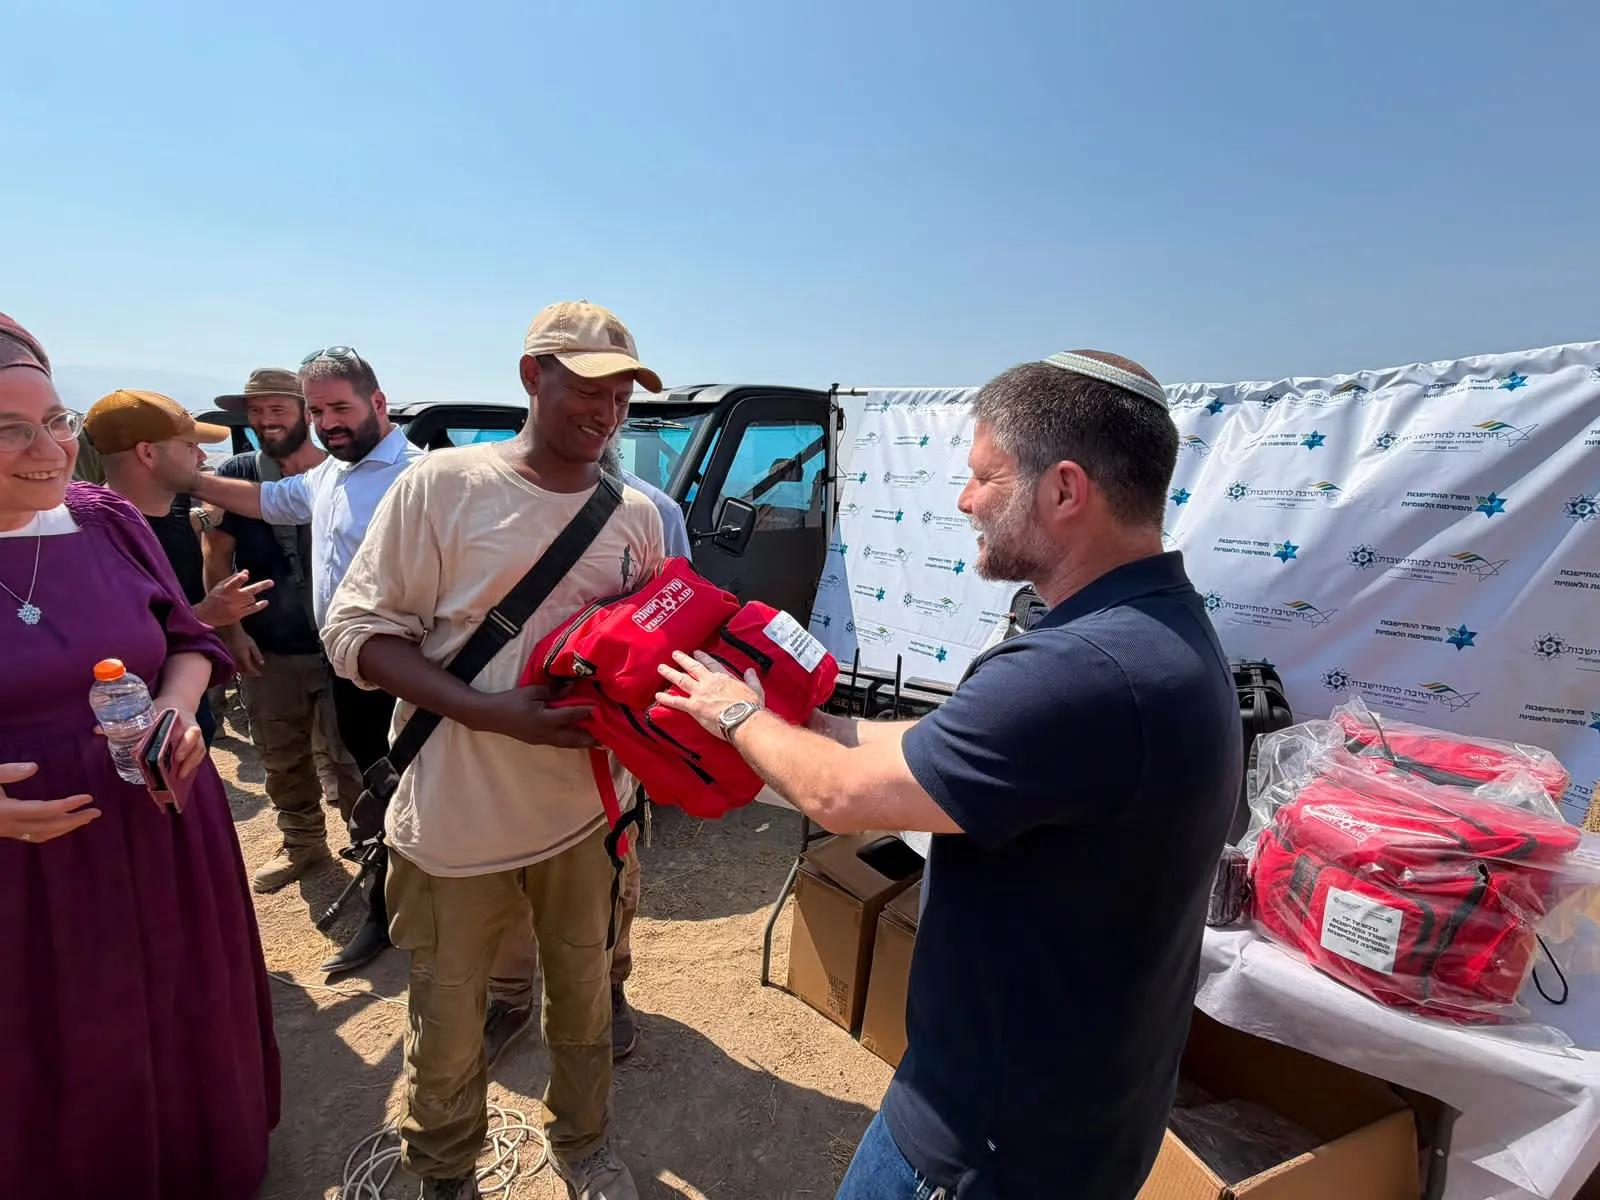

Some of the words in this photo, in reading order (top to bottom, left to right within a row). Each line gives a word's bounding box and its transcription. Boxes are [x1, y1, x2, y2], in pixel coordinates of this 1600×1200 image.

[1406, 491, 1448, 499] ההתיישבות
[1401, 501, 1435, 509] הלאומיות
[1435, 503, 1472, 511] והמשימות
[1379, 556, 1431, 567] להתיישבות
[1433, 561, 1472, 572] החטיבה
[1553, 579, 1589, 589] הלאומיות
[644, 610, 668, 630] FIRST
[677, 588, 692, 603] AID
[1225, 602, 1270, 614] להתיישבות
[1270, 608, 1305, 619] החטיבה
[1380, 619, 1420, 629] ההתיישבות
[1375, 628, 1406, 638] הלאומיות
[1407, 633, 1443, 642] והמשימות
[1351, 680, 1402, 694] להתיישבות
[1404, 688, 1443, 701] החטיבה
[1525, 704, 1565, 713] ההתיישבות
[1518, 713, 1551, 723] הלאומיות
[1552, 717, 1586, 726] והמשימות
[1329, 922, 1356, 938] הלאומיות
[1332, 917, 1366, 935] ההתיישבות
[1326, 927, 1360, 945] להתיישבות
[1367, 931, 1388, 942] משרד
[1357, 934, 1391, 950] והמשימות
